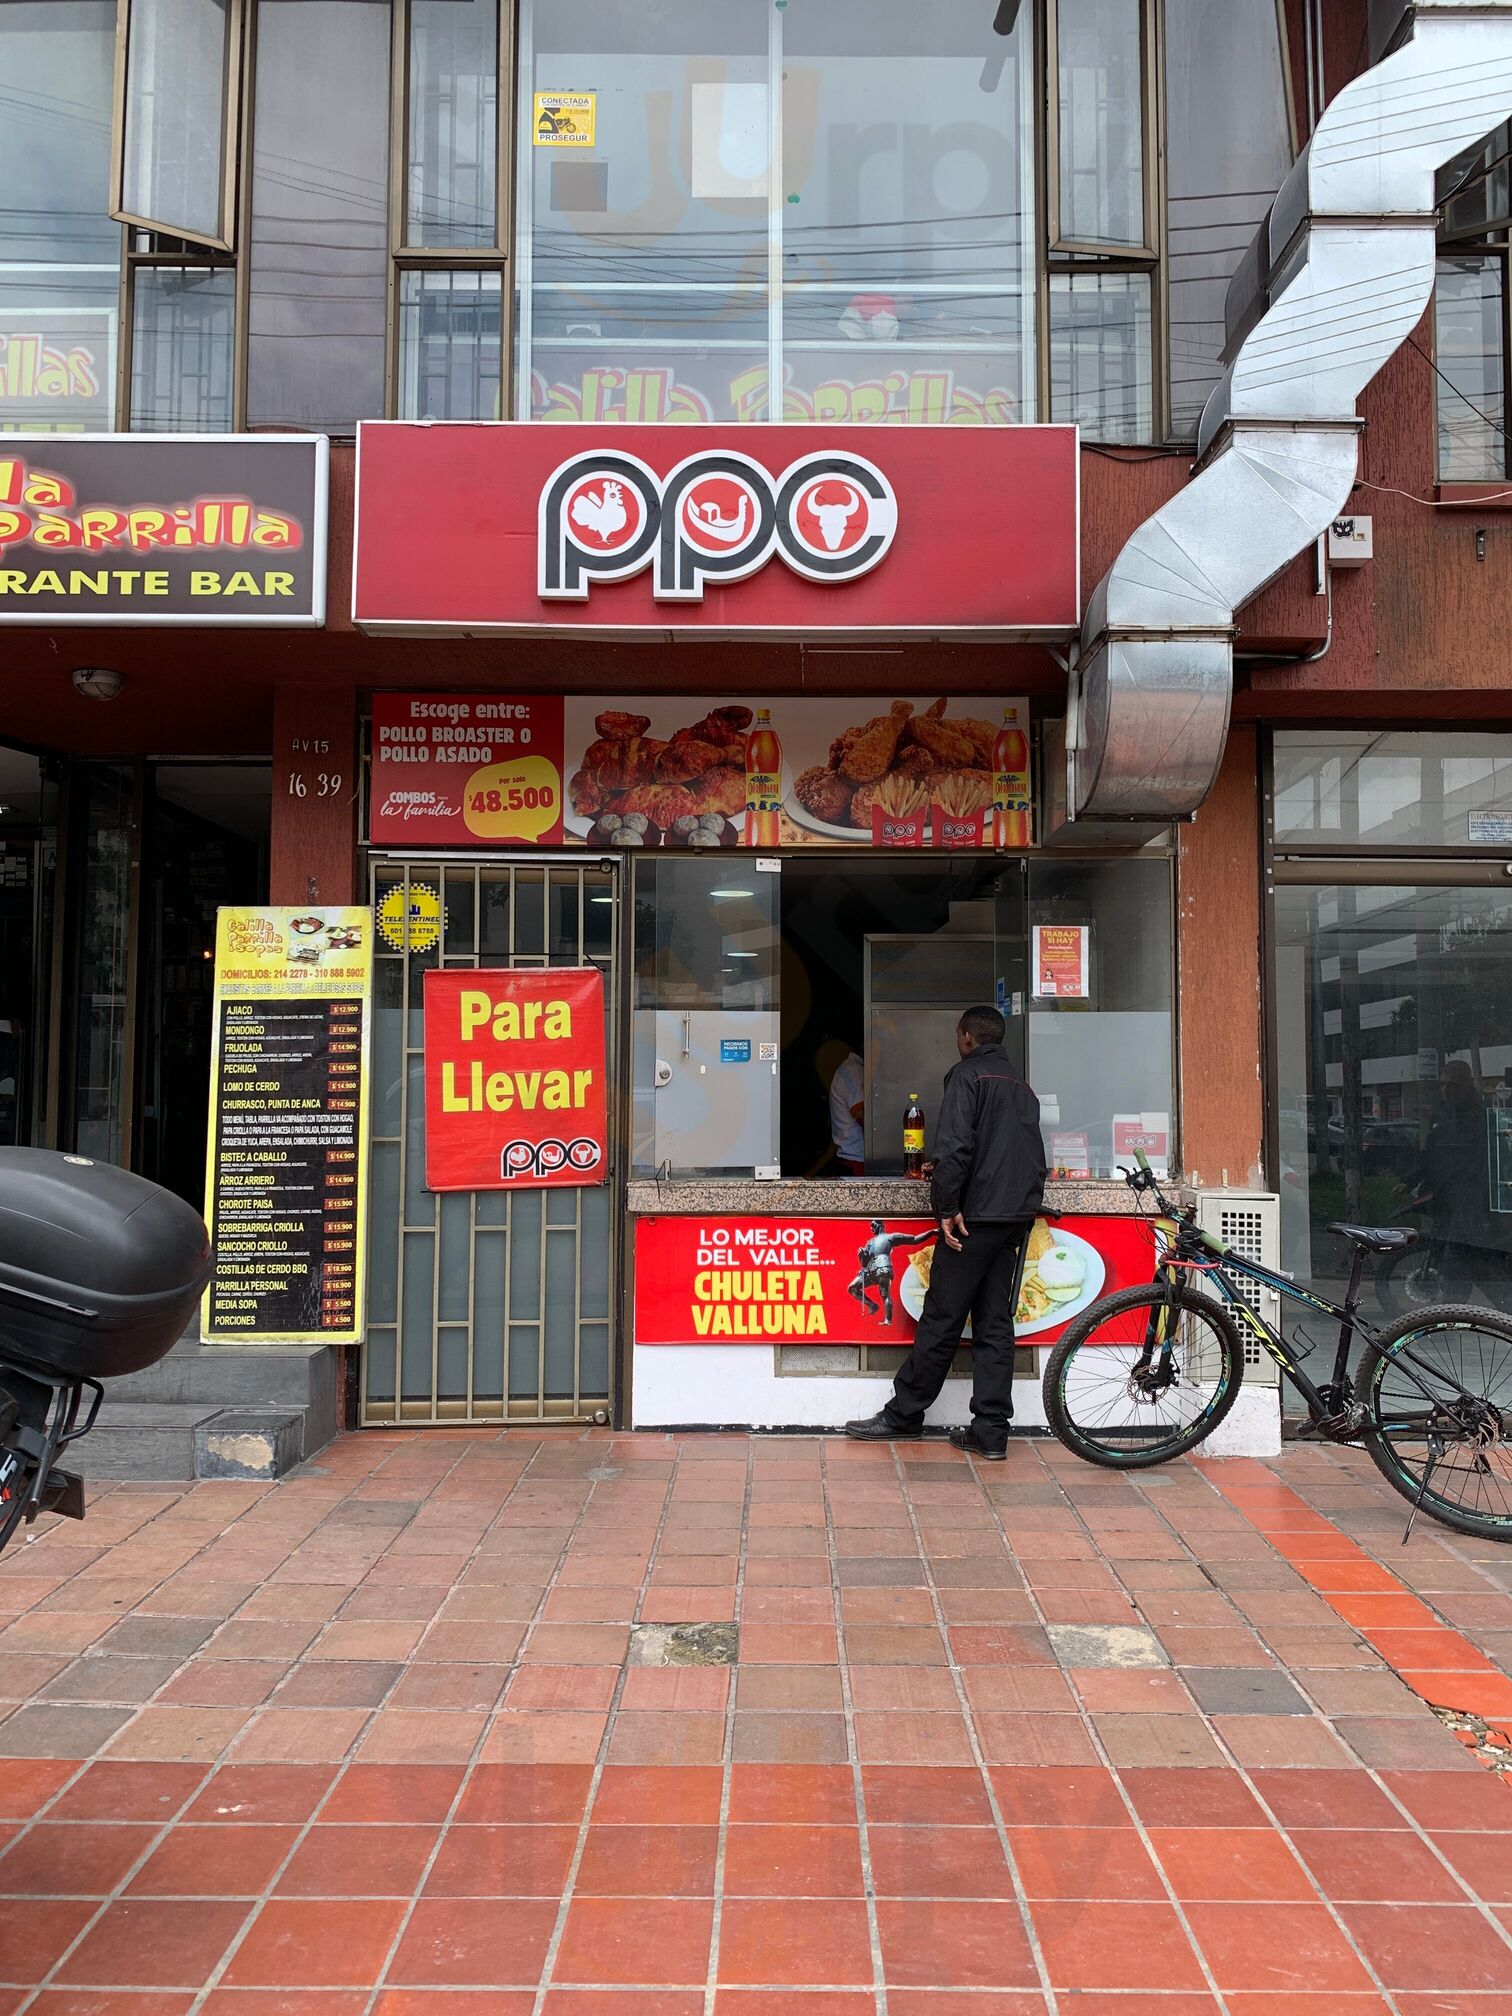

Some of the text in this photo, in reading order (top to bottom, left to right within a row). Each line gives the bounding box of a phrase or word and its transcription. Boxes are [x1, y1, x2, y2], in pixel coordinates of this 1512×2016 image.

[540, 134, 588, 142] PROSEGUR
[190, 571, 296, 596] BAR
[410, 702, 530, 724] Escoge entre:
[380, 727, 531, 743] POLLO BROASTER O
[292, 738, 329, 753] AV 15
[380, 746, 492, 763] POLLO ASADO
[290, 773, 341, 797] 16 39
[390, 792, 436, 803] COMBOS
[380, 801, 461, 820] la familia
[221, 968, 364, 979] DOMICILIOS: 214 2278 310 888 5902
[226, 1006, 252, 1015] AJIACO
[460, 991, 572, 1041] Para
[225, 1026, 264, 1034] MONDONGO
[225, 1043, 262, 1052] FRIJOLADA
[224, 1064, 257, 1074] PECHUGA
[223, 1082, 280, 1092] LOMO DE CERDO
[442, 1062, 592, 1112] Llevar
[223, 1099, 321, 1110] CHURRASCO, PUNTA DE ANCA
[220, 1152, 287, 1162] BISTEC A CABALLO
[220, 1176, 274, 1186] ARROZ ARRIERO
[252, 1200, 273, 1208] PAISA
[218, 1222, 304, 1232] SOBREBARRIGA CRIOLLA
[700, 1228, 814, 1246] LO MEJOR
[217, 1241, 287, 1251] SANCOCHO CRIOLLO
[697, 1249, 835, 1266] DEL VALLE...
[216, 1264, 307, 1274] COSTILLAS DE CERDO BBQ
[216, 1281, 288, 1291] PARRILLA PERSONAL
[694, 1270, 824, 1301] CHULETA
[216, 1300, 257, 1309] MEDIA SOPA
[215, 1316, 255, 1326] PORCIONES
[691, 1305, 827, 1335] VALLUNA
